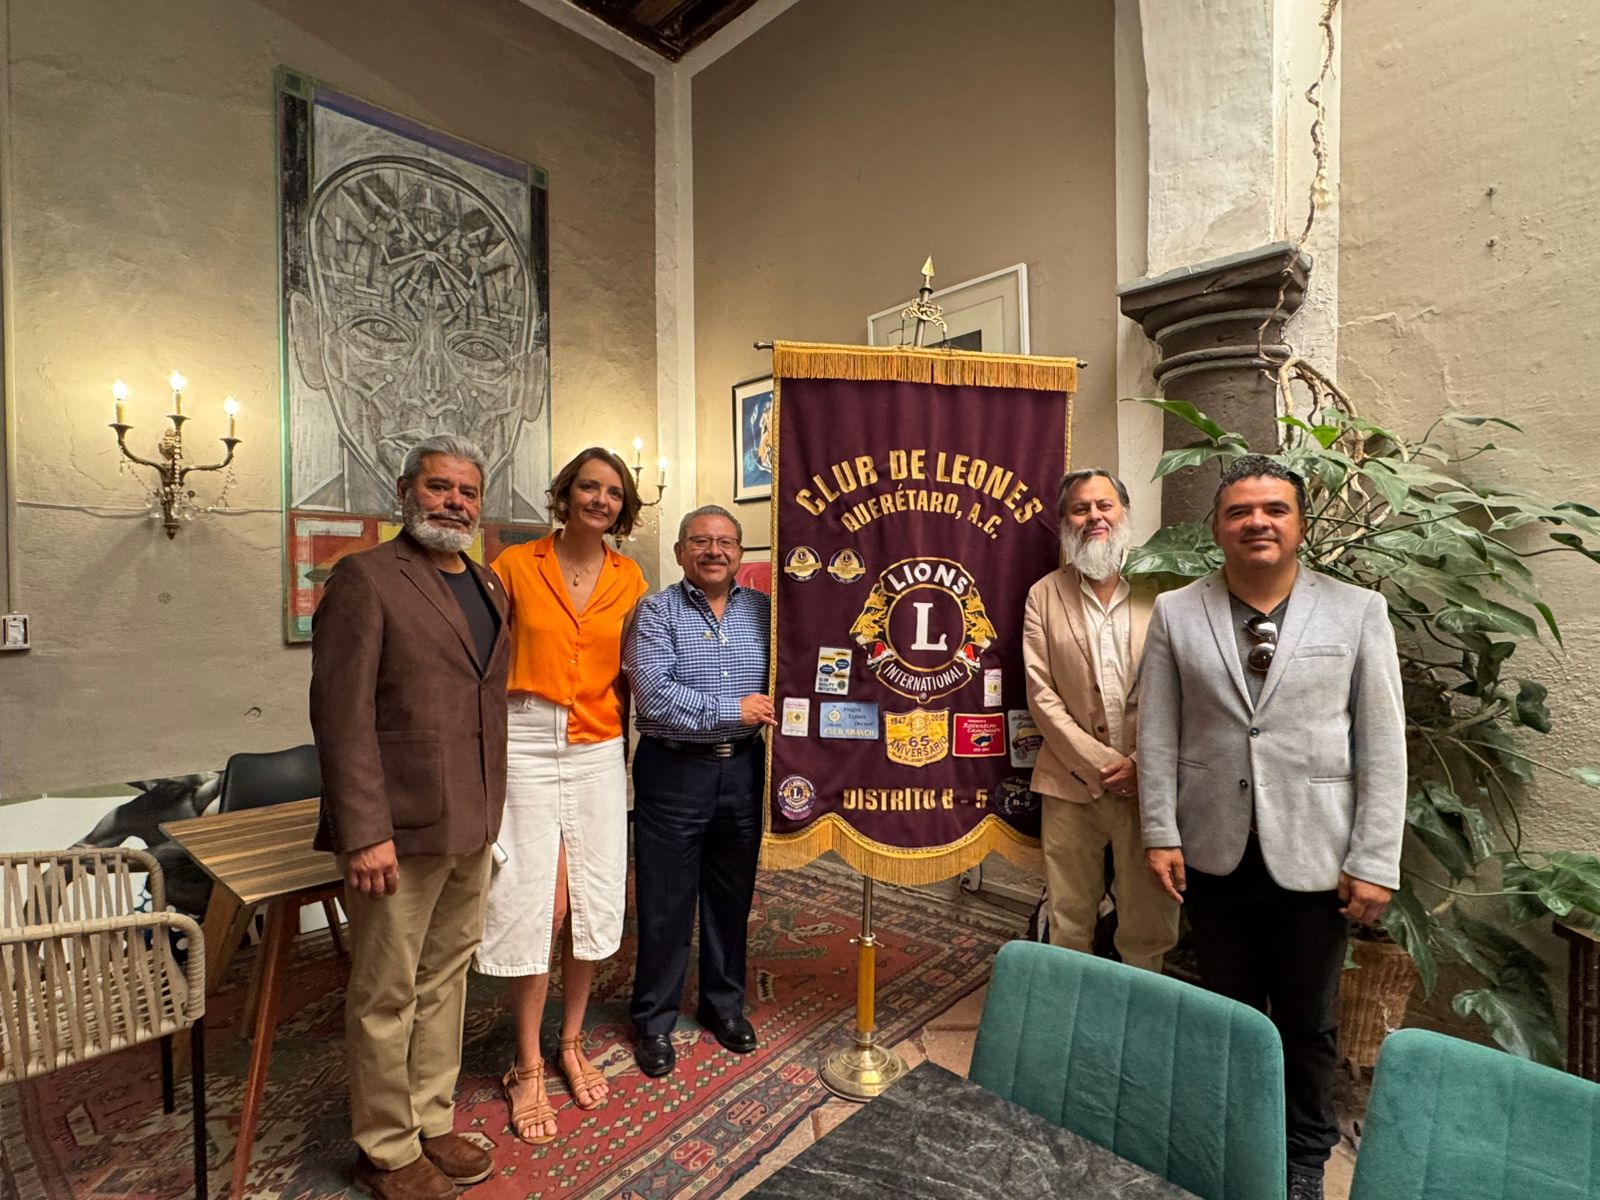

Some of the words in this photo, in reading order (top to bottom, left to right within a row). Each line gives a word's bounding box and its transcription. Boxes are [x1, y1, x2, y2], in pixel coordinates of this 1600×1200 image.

[796, 455, 878, 516] CLUB
[890, 449, 926, 480] DE
[936, 452, 1043, 524] LEONES
[840, 482, 962, 533] QUERÉTARO,
[968, 502, 1002, 540] A.C.
[888, 562, 968, 596] LIONS
[911, 602, 948, 650] L
[883, 663, 964, 692] INTERNATIONAL
[888, 736, 947, 757] ANIVERSARIO
[908, 736, 930, 747] 65
[844, 788, 936, 811] DISTRITO
[976, 789, 988, 809] 5
